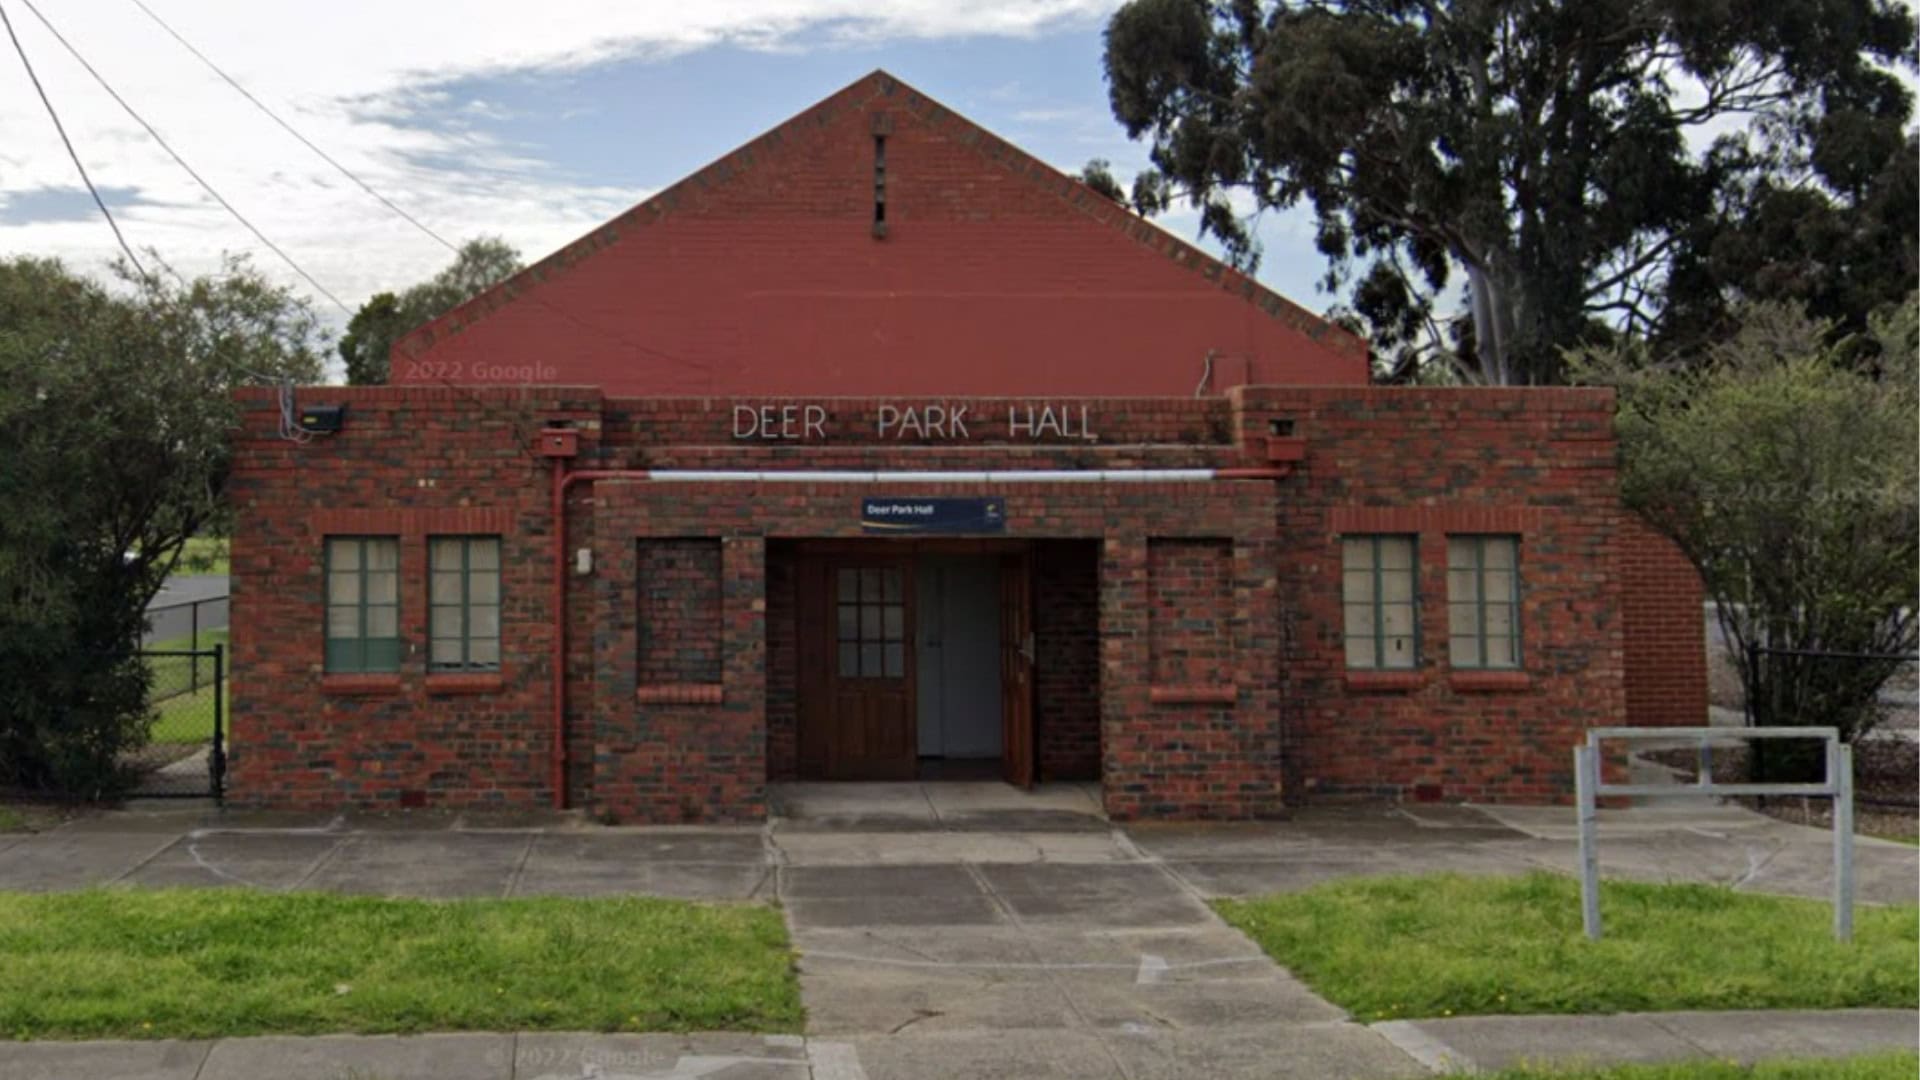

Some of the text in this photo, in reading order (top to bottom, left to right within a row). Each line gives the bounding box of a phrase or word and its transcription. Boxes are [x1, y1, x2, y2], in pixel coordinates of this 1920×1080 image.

[732, 404, 1099, 441] DEER PARK HALL
[867, 504, 934, 515] Deer Park Hall
